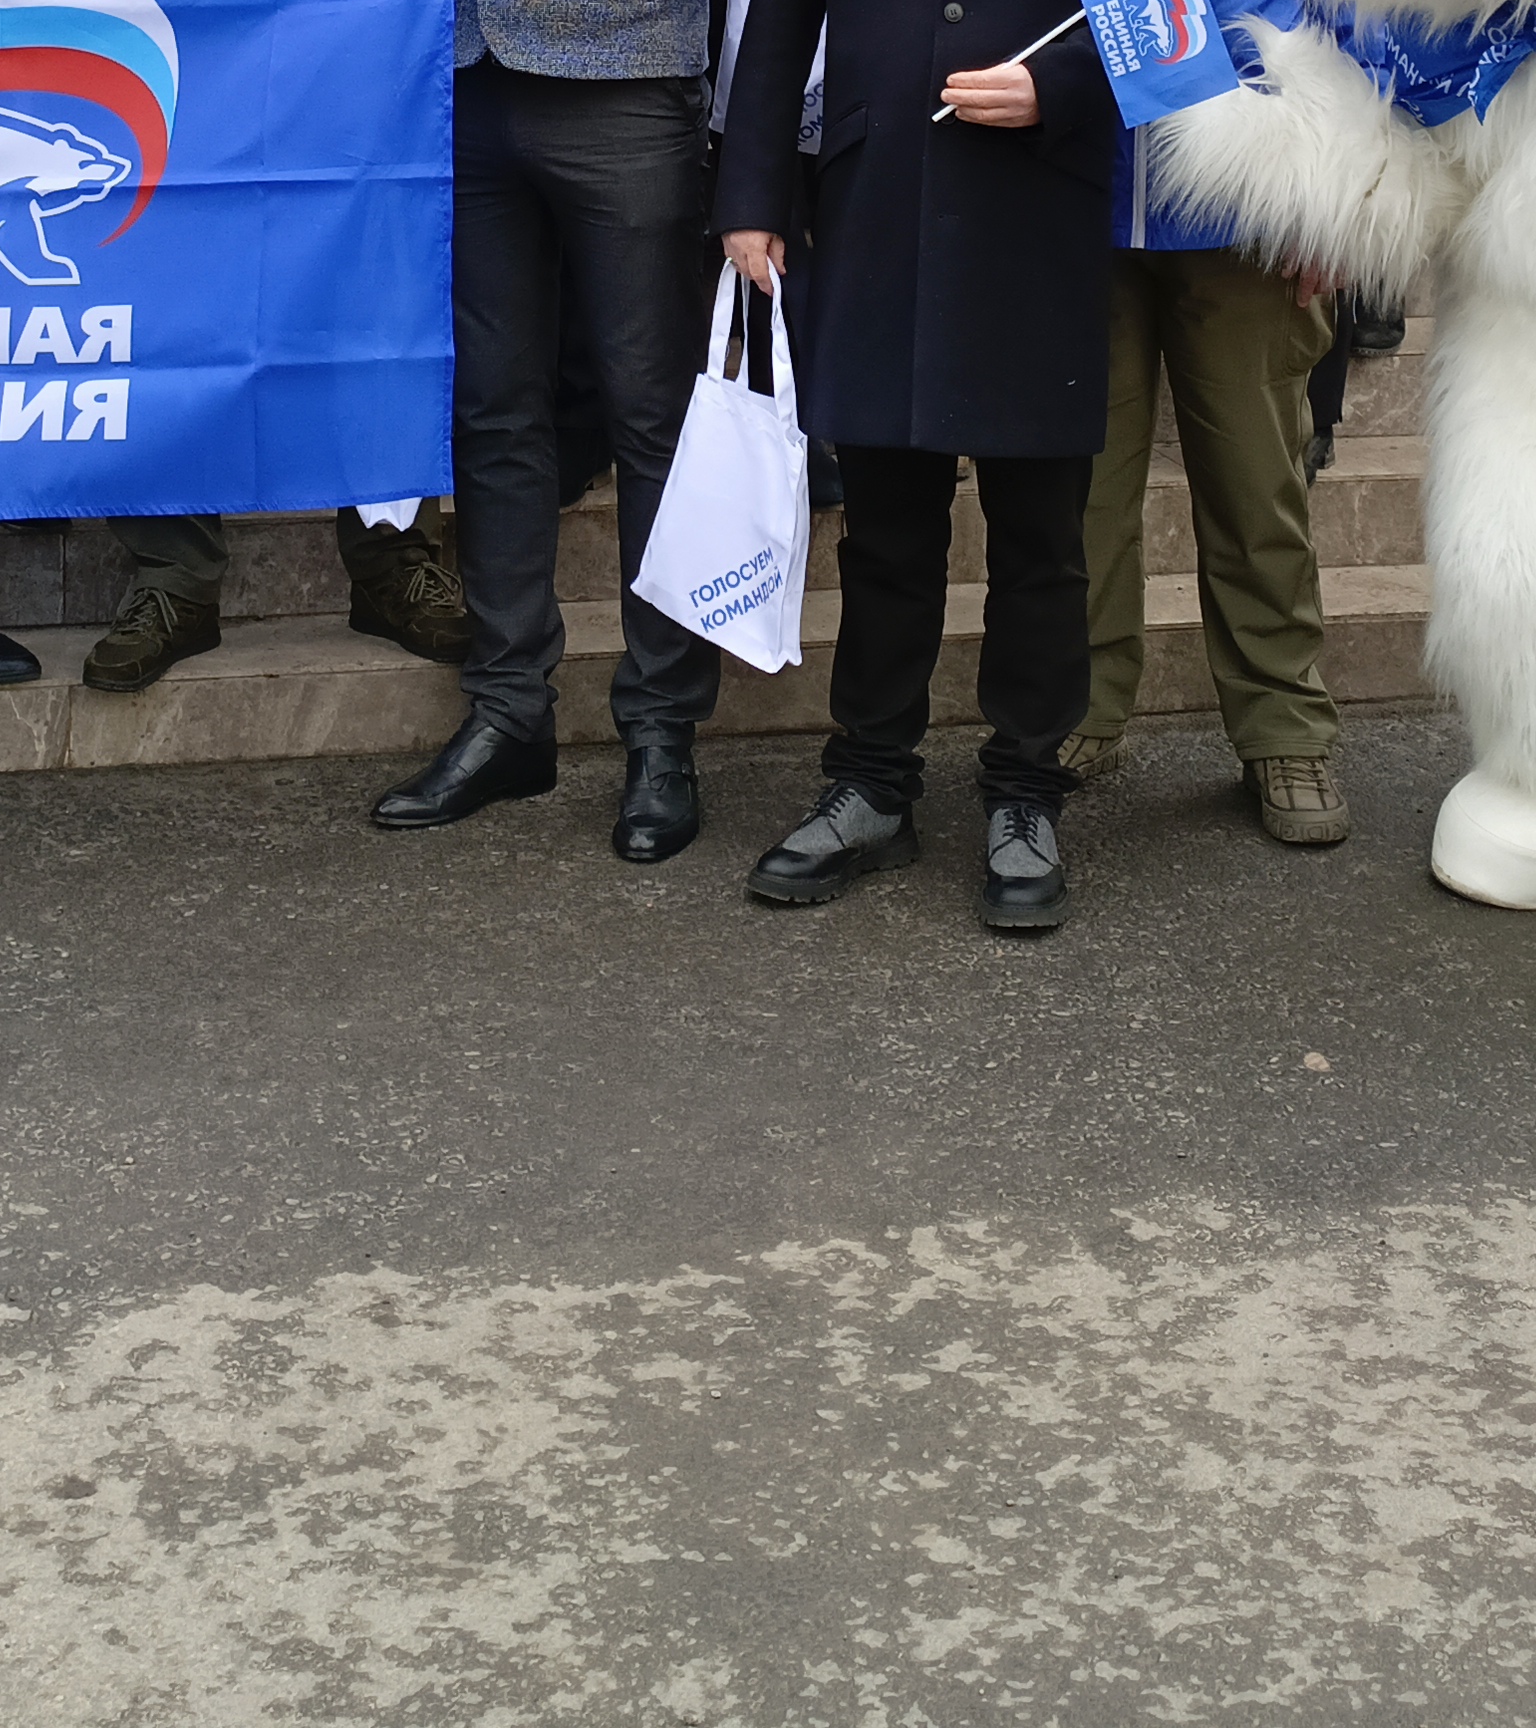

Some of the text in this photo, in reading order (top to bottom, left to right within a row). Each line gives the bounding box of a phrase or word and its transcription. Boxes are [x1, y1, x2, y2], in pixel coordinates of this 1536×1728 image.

[1091, 3, 1127, 78] РОССИЯ
[1106, 0, 1142, 73] ЕДИНАЯ
[688, 545, 774, 609] ГОЛОСУЕМ
[700, 567, 783, 634] КОМАНДОЙ
